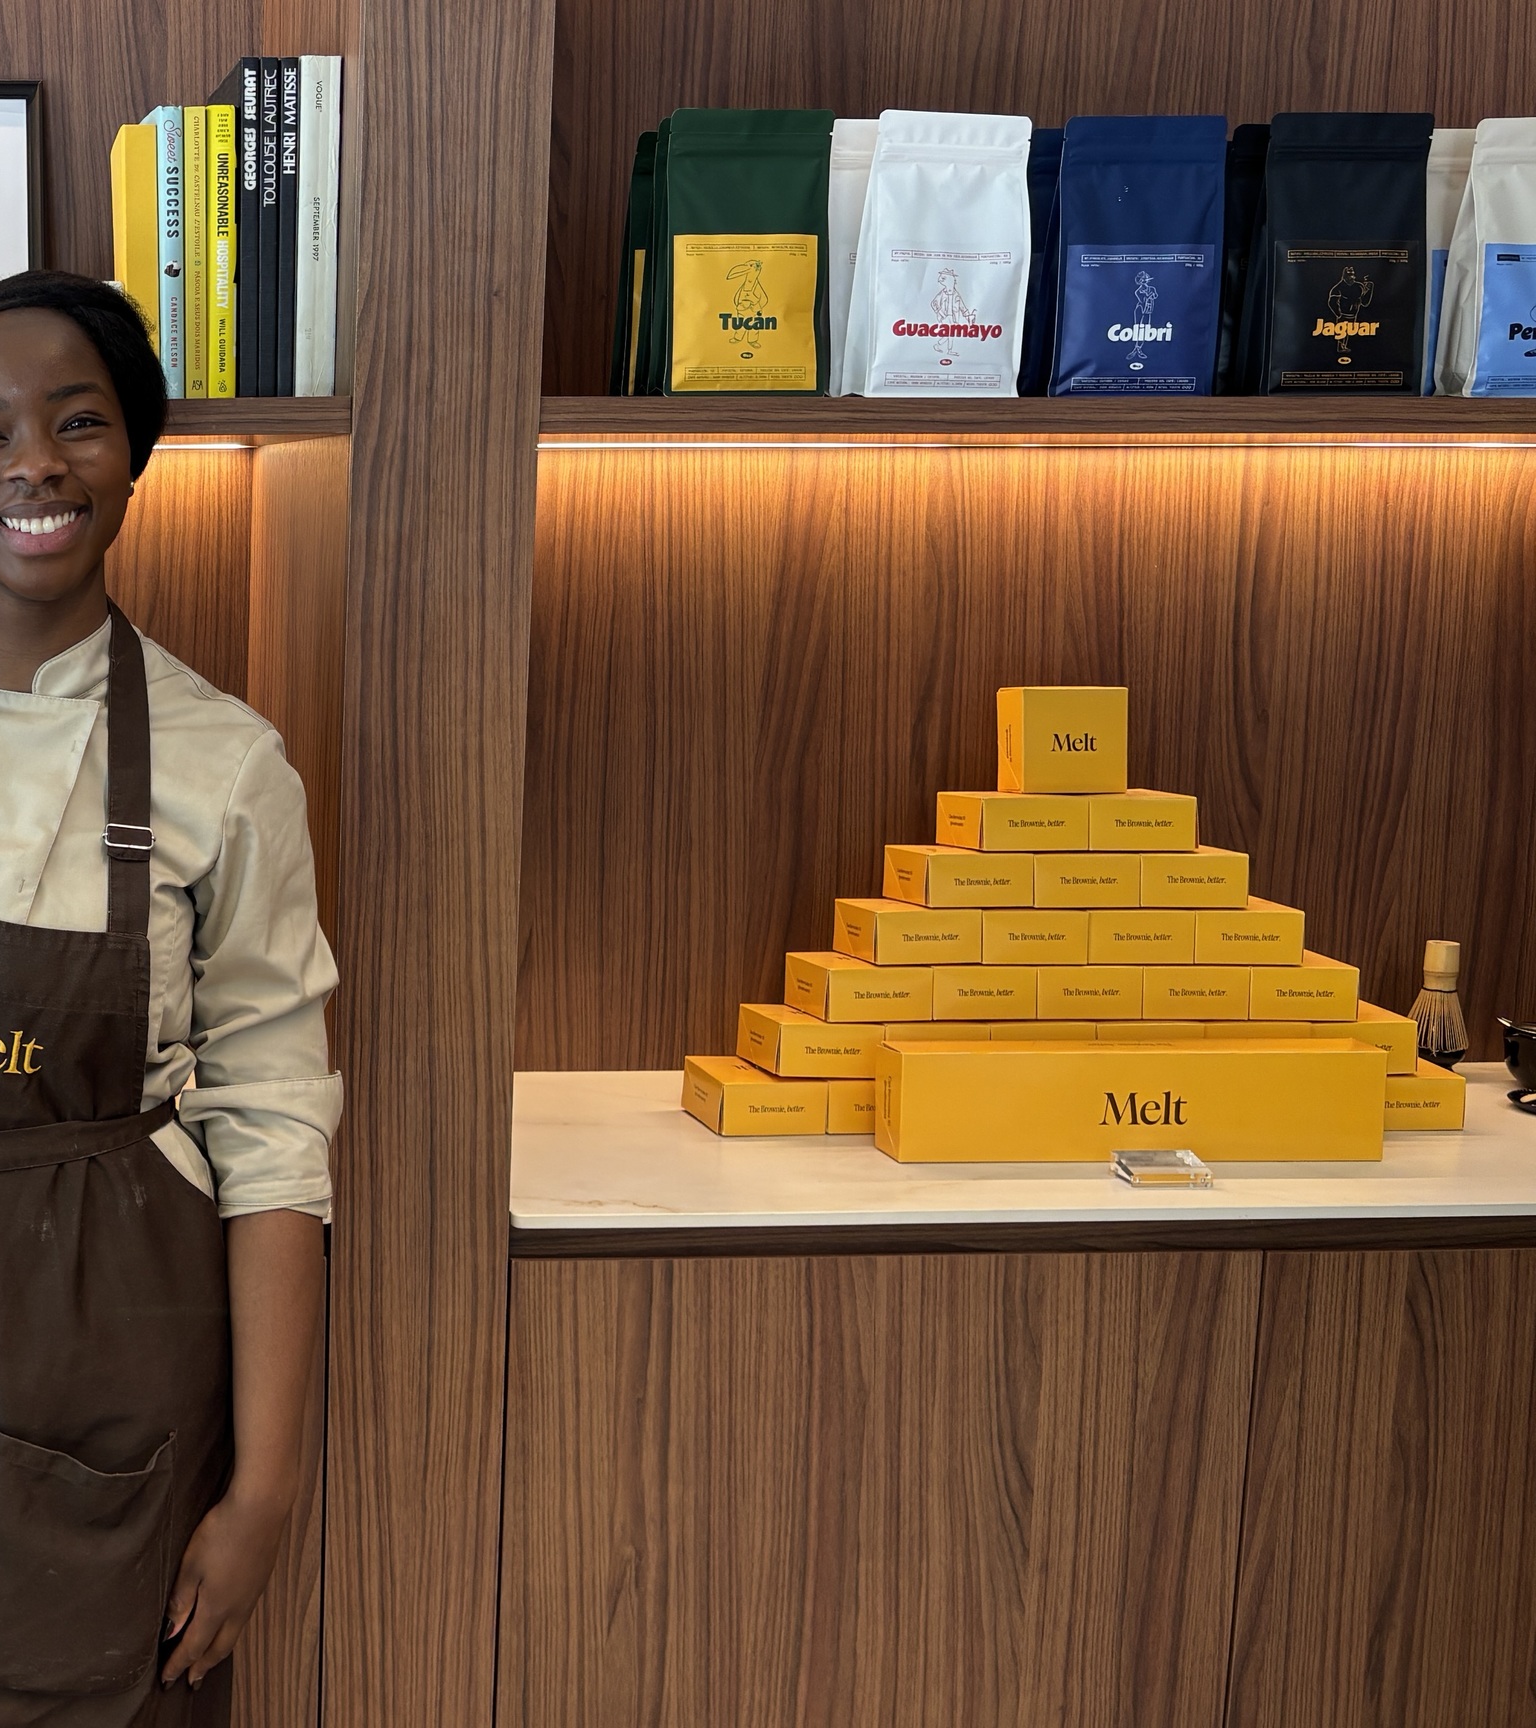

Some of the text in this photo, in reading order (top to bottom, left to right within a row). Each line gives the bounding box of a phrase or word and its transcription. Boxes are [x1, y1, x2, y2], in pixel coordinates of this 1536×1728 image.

[283, 68, 296, 174] HENRI MATISSE
[244, 68, 257, 190] GEORGES SEURAT
[263, 69, 277, 207] TOULOUSE LAUTREC
[163, 119, 183, 239] Sweet SUCCESS
[193, 175, 201, 217] CASTELNAU
[217, 152, 230, 237] UNREASONABLE
[311, 197, 321, 262] SEPTEMBER 1997
[216, 240, 228, 309] HOSPITALITY
[170, 297, 178, 368] CANDACE NELSON
[218, 318, 226, 336] WILL
[892, 319, 1003, 341] Guacamayo
[1312, 318, 1380, 340] Jaguar
[218, 339, 226, 373] GUIDARA
[1050, 733, 1098, 753] Melt
[1008, 818, 1066, 829] The Brownie, better.
[1115, 818, 1174, 829] The Brownie, better.
[954, 877, 1012, 887] The Brownie, better.
[1060, 875, 1118, 886] The Brownie, better.
[1167, 875, 1226, 885] The Brownie, better.
[902, 932, 960, 943] The Brownie, better.
[1008, 932, 1067, 942] The Brownie, better.
[1113, 932, 1172, 942] The Brownie, better.
[1221, 932, 1281, 942] The Brownie, better.
[854, 990, 911, 1000] The Brownie, better.
[957, 988, 1015, 998] The Brownie, better.
[1063, 987, 1121, 997] The Brownie, better.
[1169, 987, 1227, 998] The Brownie, better.
[1276, 988, 1335, 999] The Brownie, better.
[805, 1045, 862, 1056] The Brownie, better.
[748, 1104, 806, 1114] The Brownie, better.
[854, 1103, 865, 1112] The
[1098, 1090, 1188, 1126] Melt
[1396, 1100, 1421, 1109] Brownie,
[1423, 1099, 1442, 1109] better.
